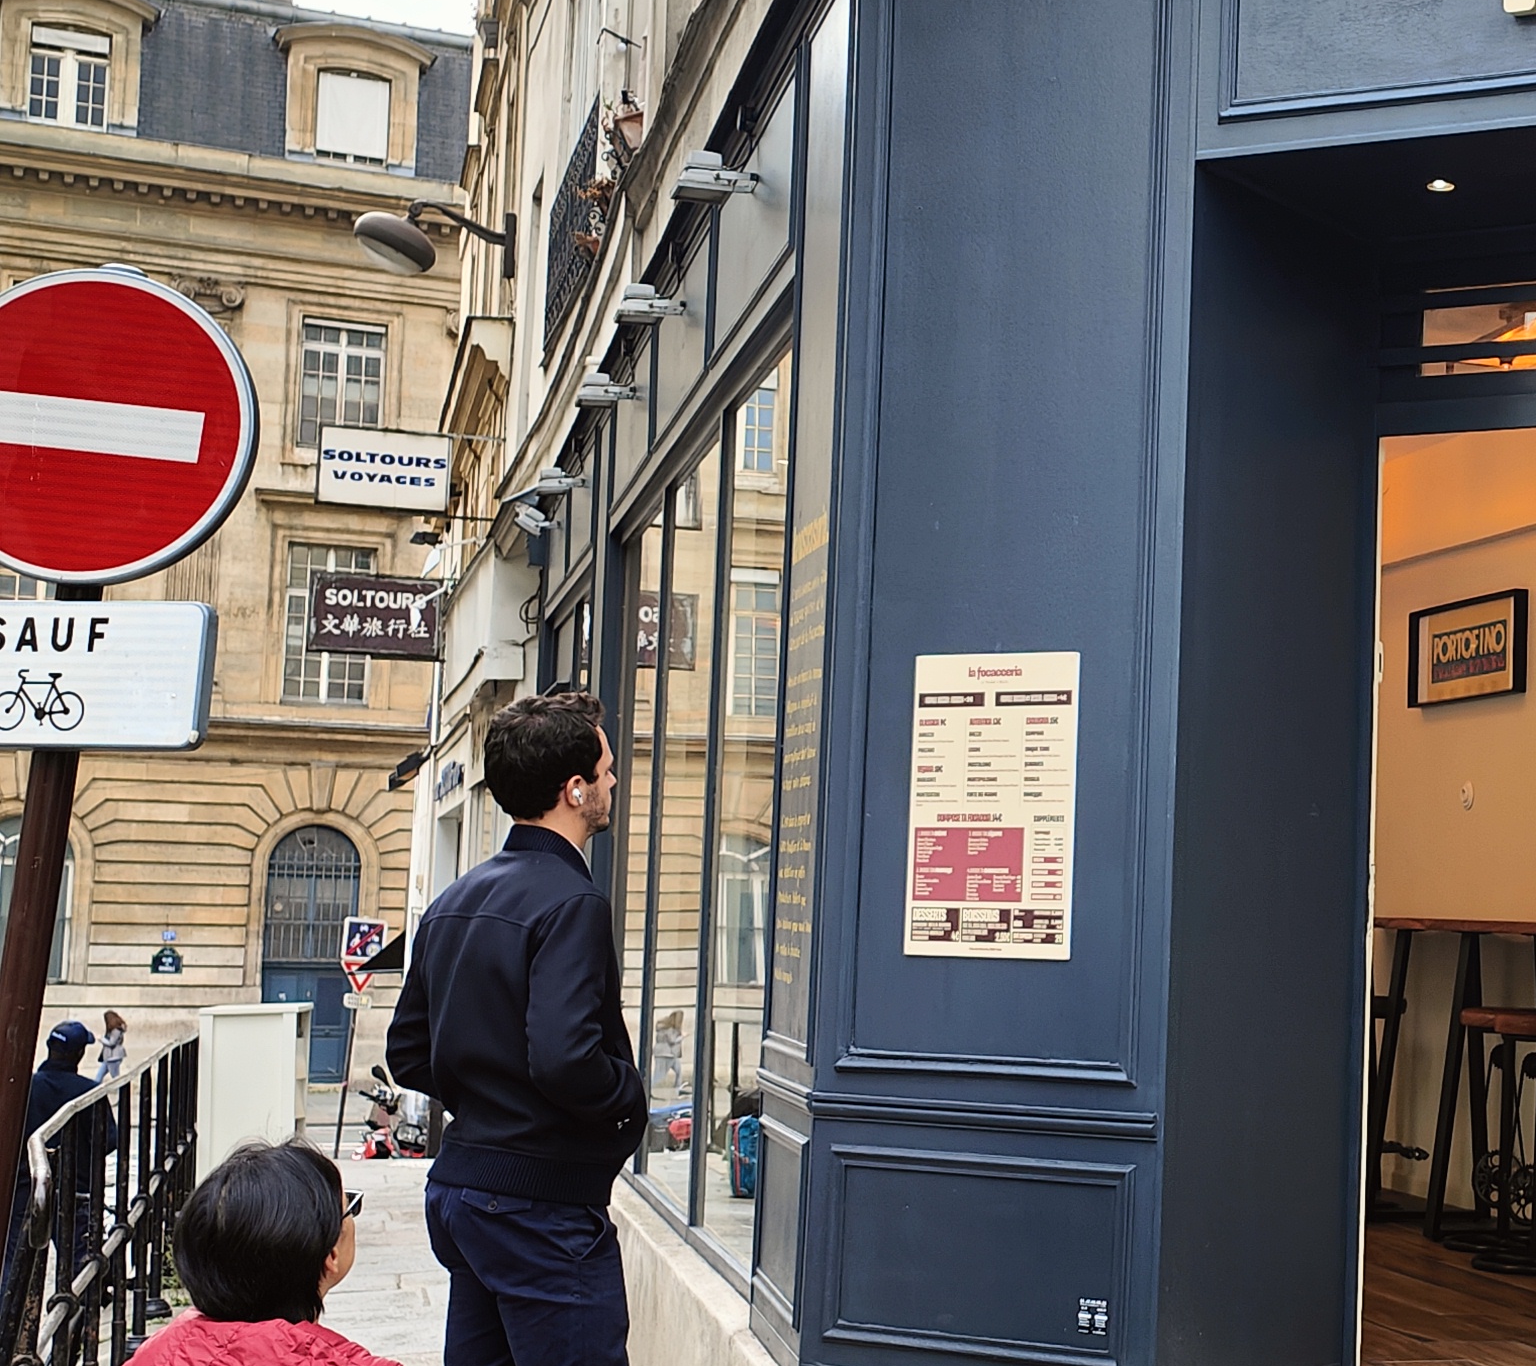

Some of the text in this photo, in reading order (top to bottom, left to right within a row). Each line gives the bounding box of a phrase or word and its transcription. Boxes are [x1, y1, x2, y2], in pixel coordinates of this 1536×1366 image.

[322, 448, 448, 470] SOLTOURS
[332, 469, 437, 487] VOYAGES
[324, 588, 428, 611] SOLTOURS
[1433, 622, 1506, 665] PORTOFINO
